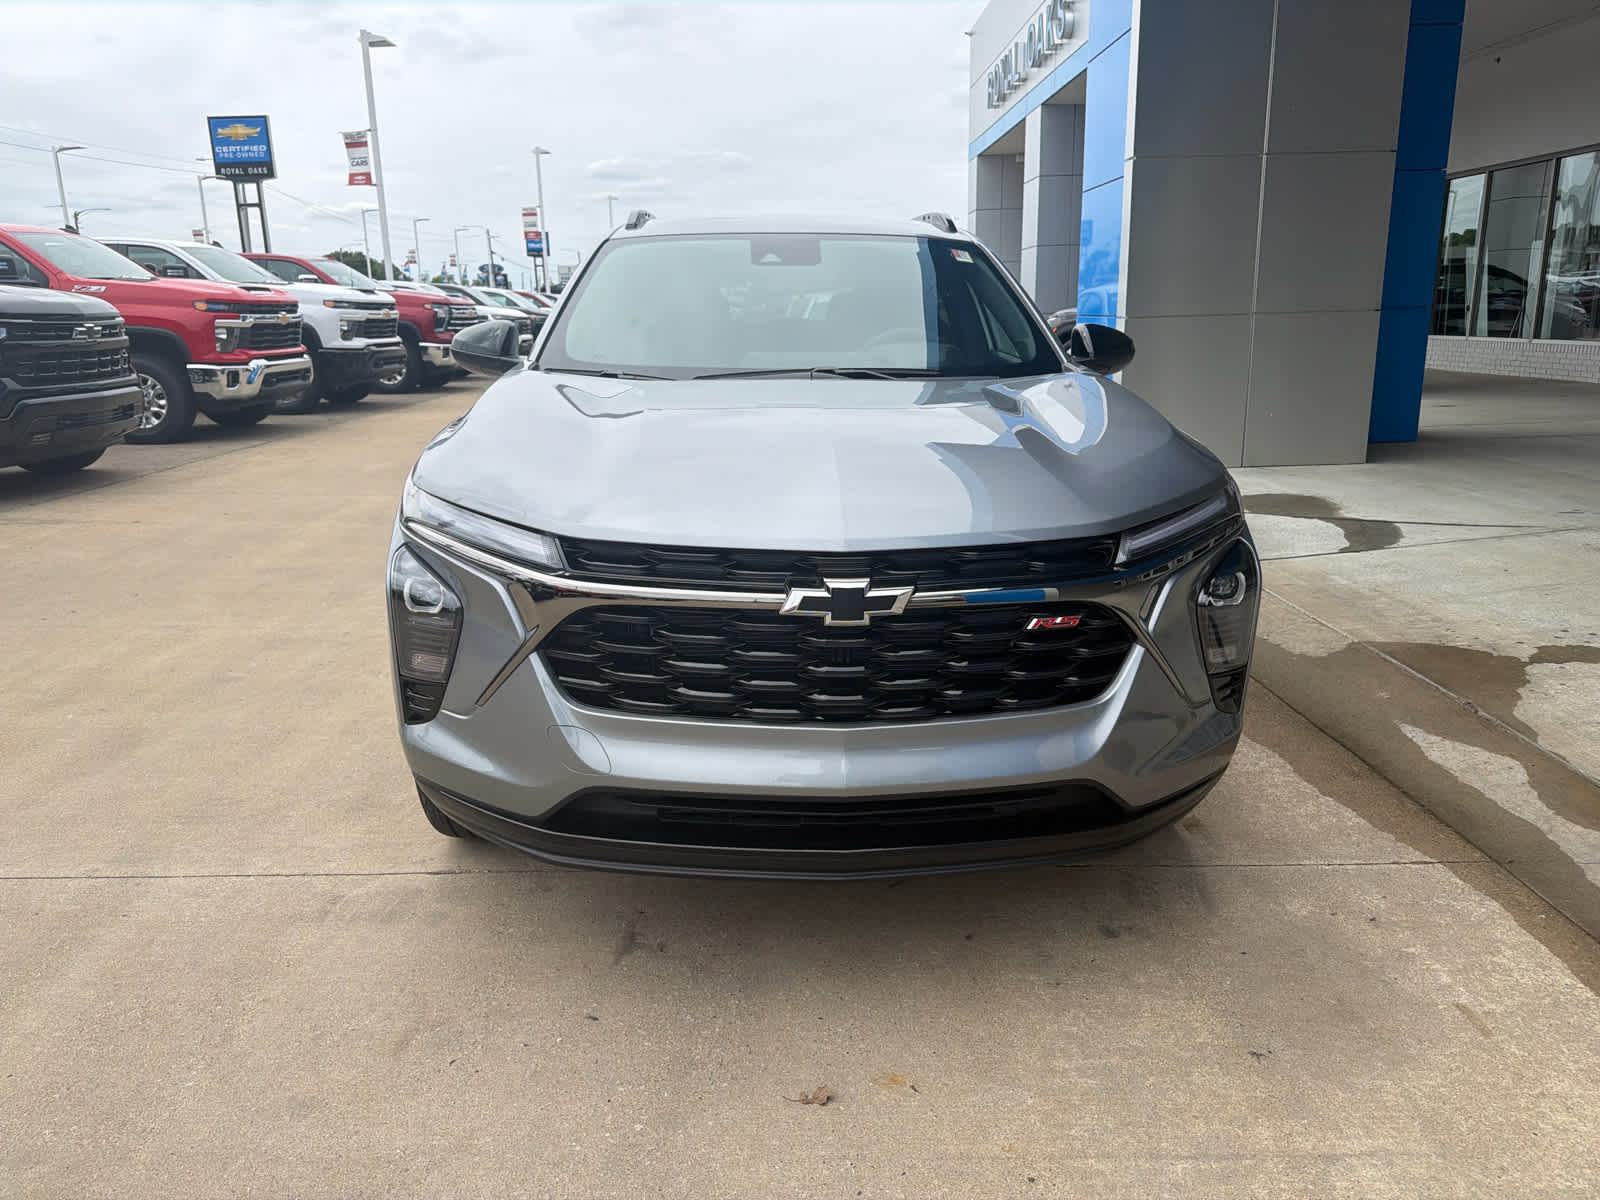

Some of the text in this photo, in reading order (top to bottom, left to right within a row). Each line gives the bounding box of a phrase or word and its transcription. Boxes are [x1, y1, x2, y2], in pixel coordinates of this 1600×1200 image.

[1027, 0, 1075, 68] OAKS
[215, 145, 266, 153] CERTIFIED
[221, 167, 267, 175] ROYAL OAKS
[1024, 616, 1081, 630] RS
